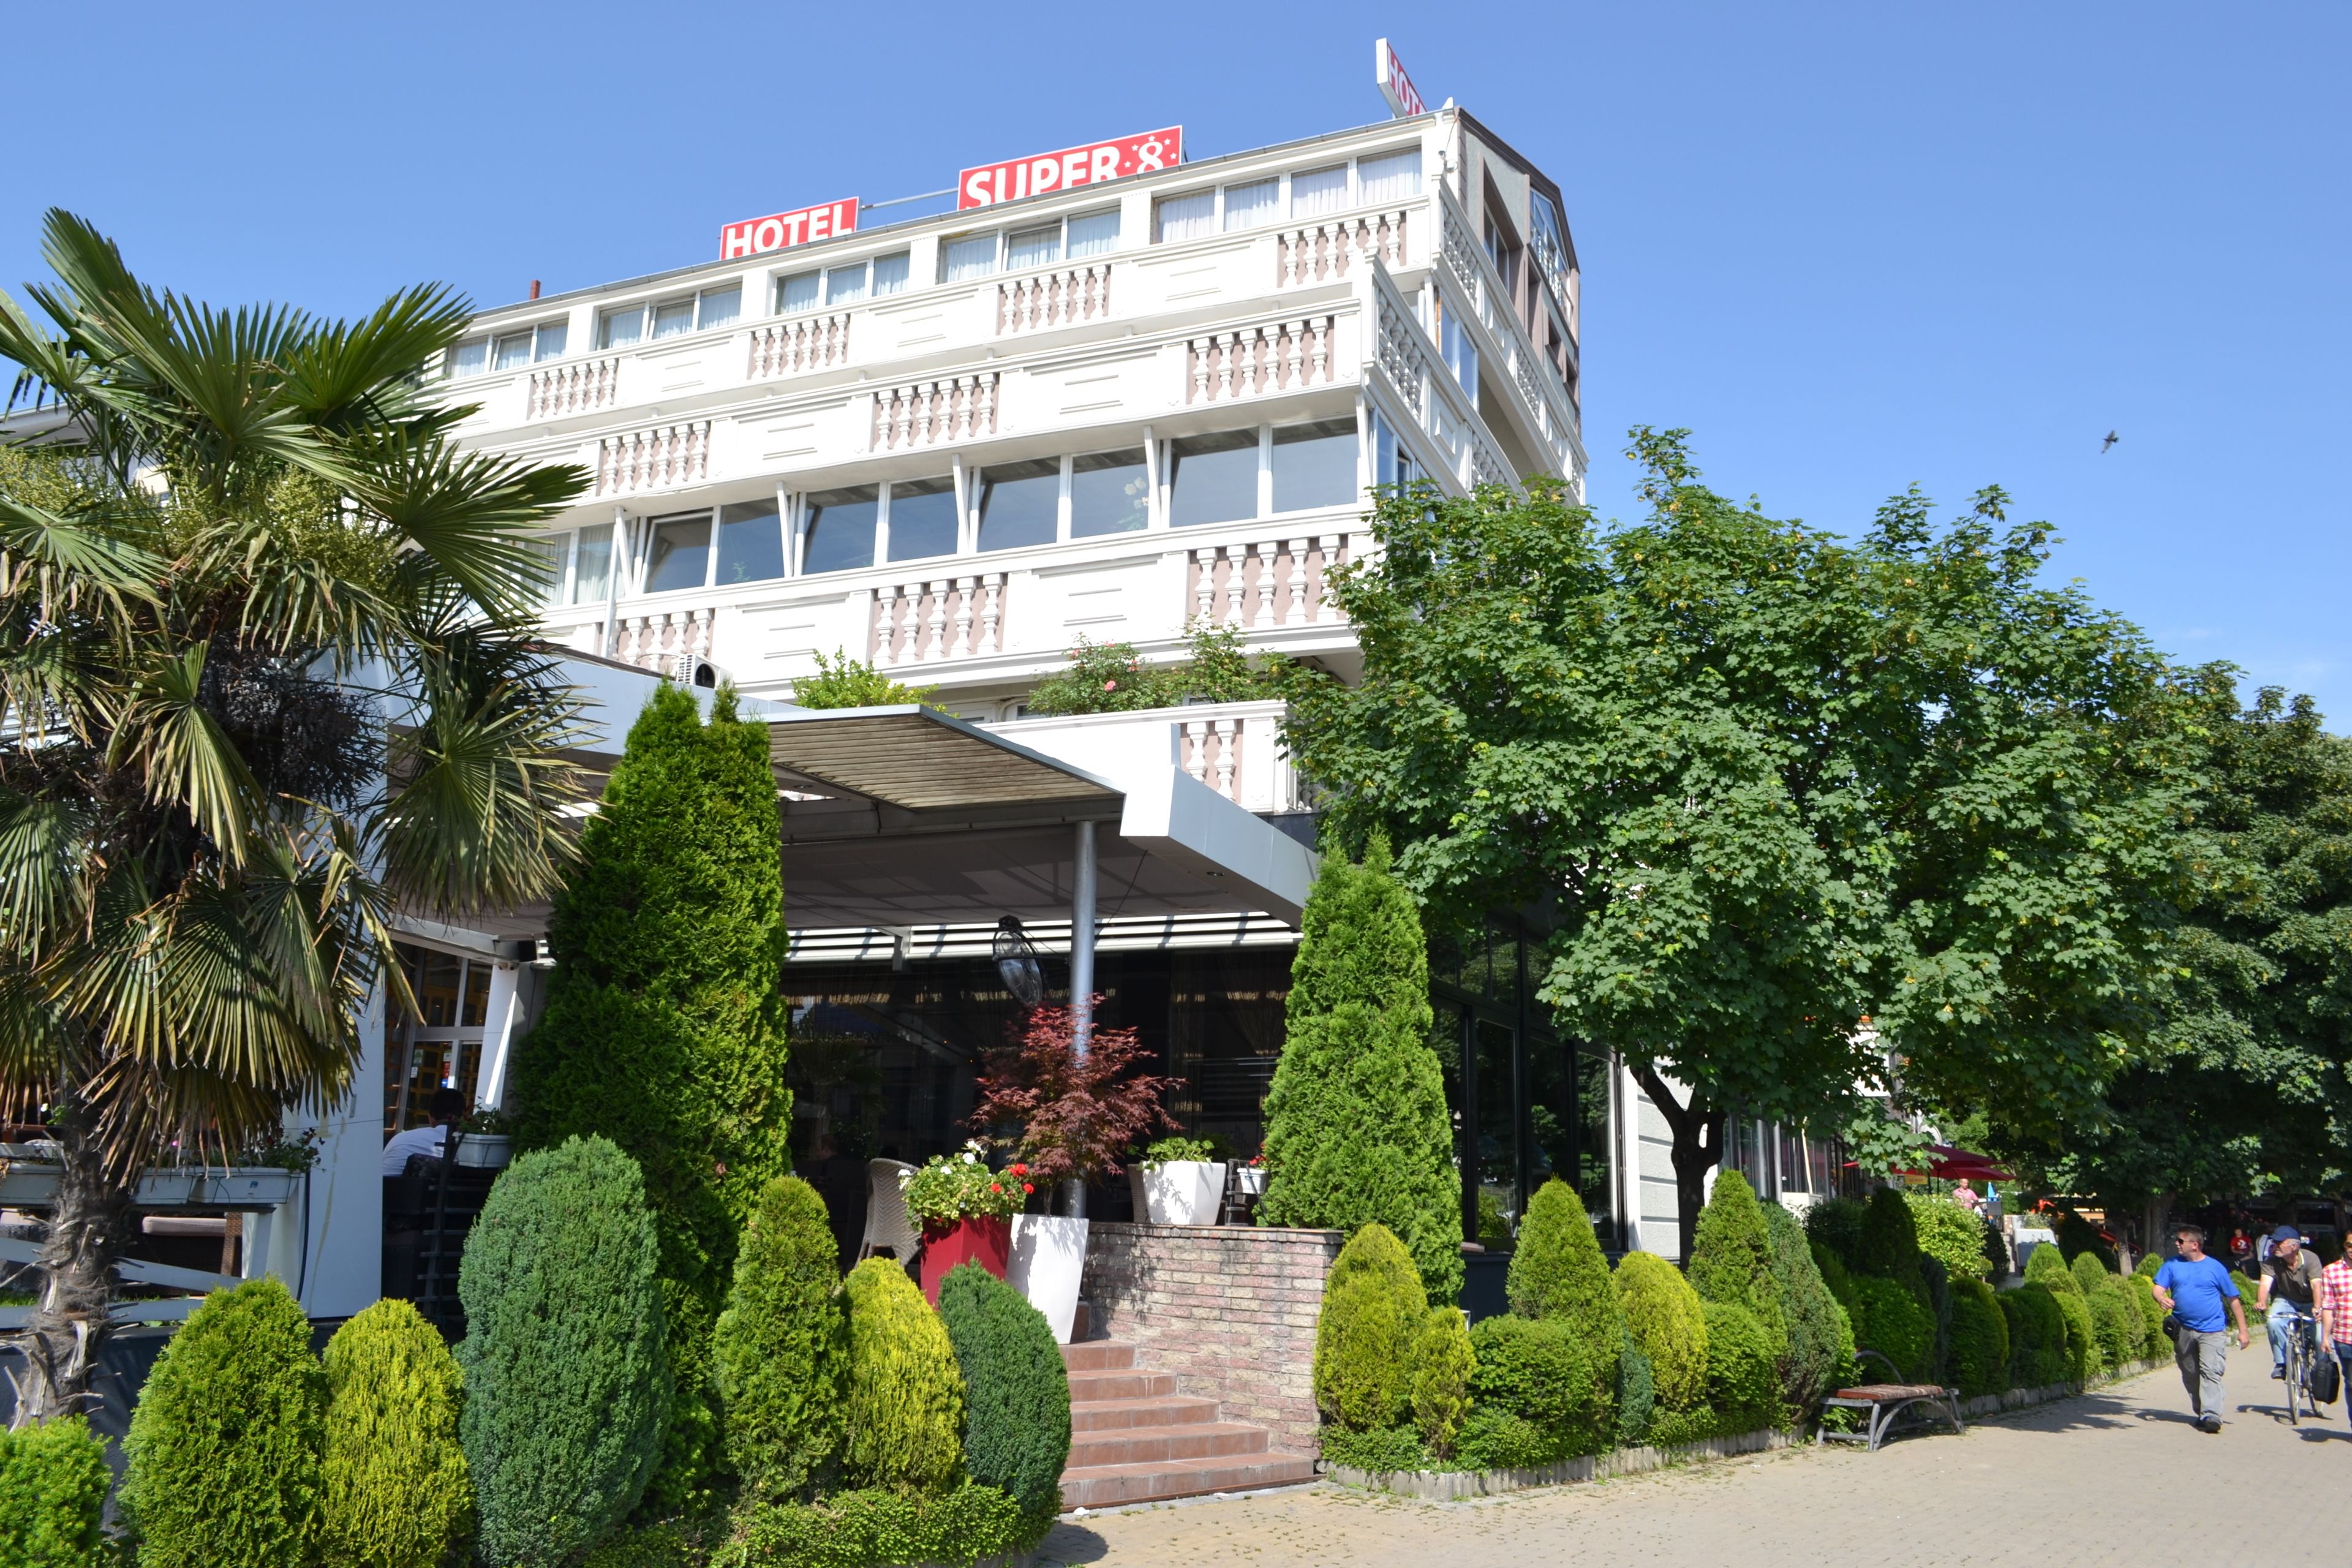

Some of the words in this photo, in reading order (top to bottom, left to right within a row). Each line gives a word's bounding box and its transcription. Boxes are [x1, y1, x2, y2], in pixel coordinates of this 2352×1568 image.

[965, 146, 1120, 209] SUPER
[1136, 141, 1164, 174] 8
[725, 204, 852, 260] HOTEL
